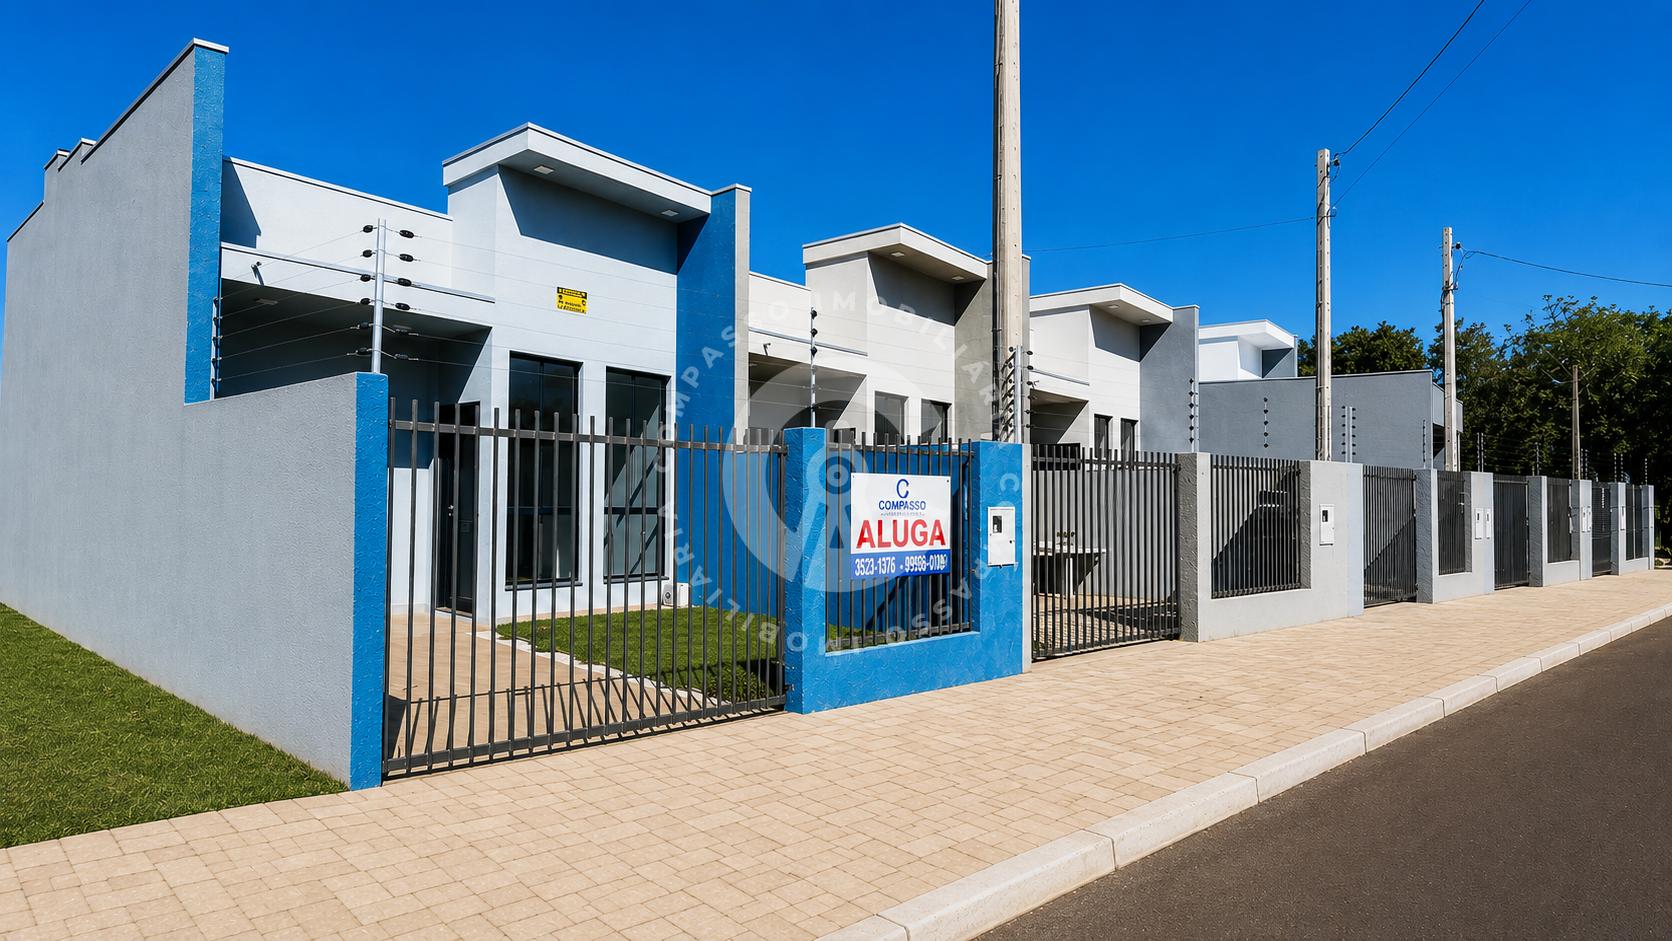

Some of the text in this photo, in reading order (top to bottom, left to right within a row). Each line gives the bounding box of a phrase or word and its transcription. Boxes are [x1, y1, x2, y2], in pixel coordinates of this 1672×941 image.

[878, 500, 926, 510] COMPASSO
[856, 519, 946, 548] ALUGA
[855, 557, 895, 576] 3523-1376
